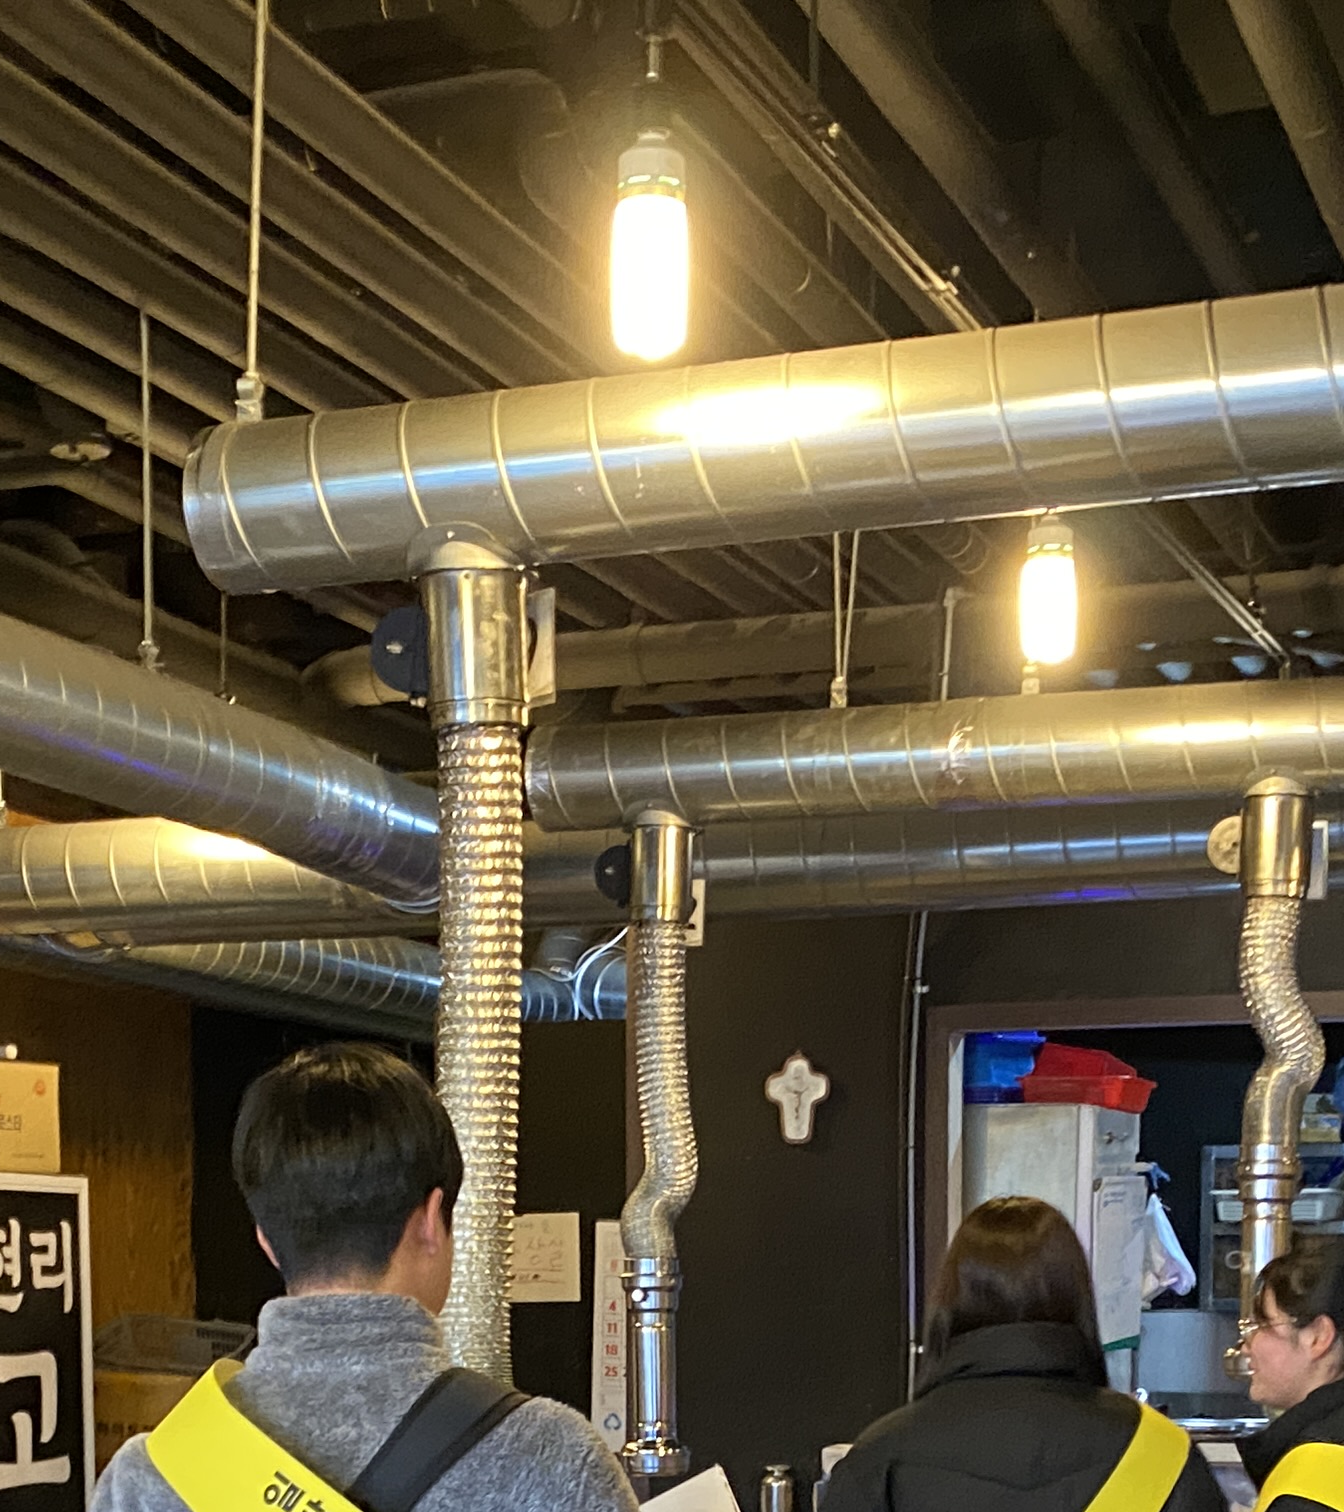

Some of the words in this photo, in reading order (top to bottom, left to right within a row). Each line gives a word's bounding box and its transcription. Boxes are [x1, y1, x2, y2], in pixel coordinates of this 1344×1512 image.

[609, 1301, 617, 1312] 4
[607, 1322, 618, 1334] 11
[605, 1344, 618, 1355] 18
[605, 1366, 618, 1377] 25
